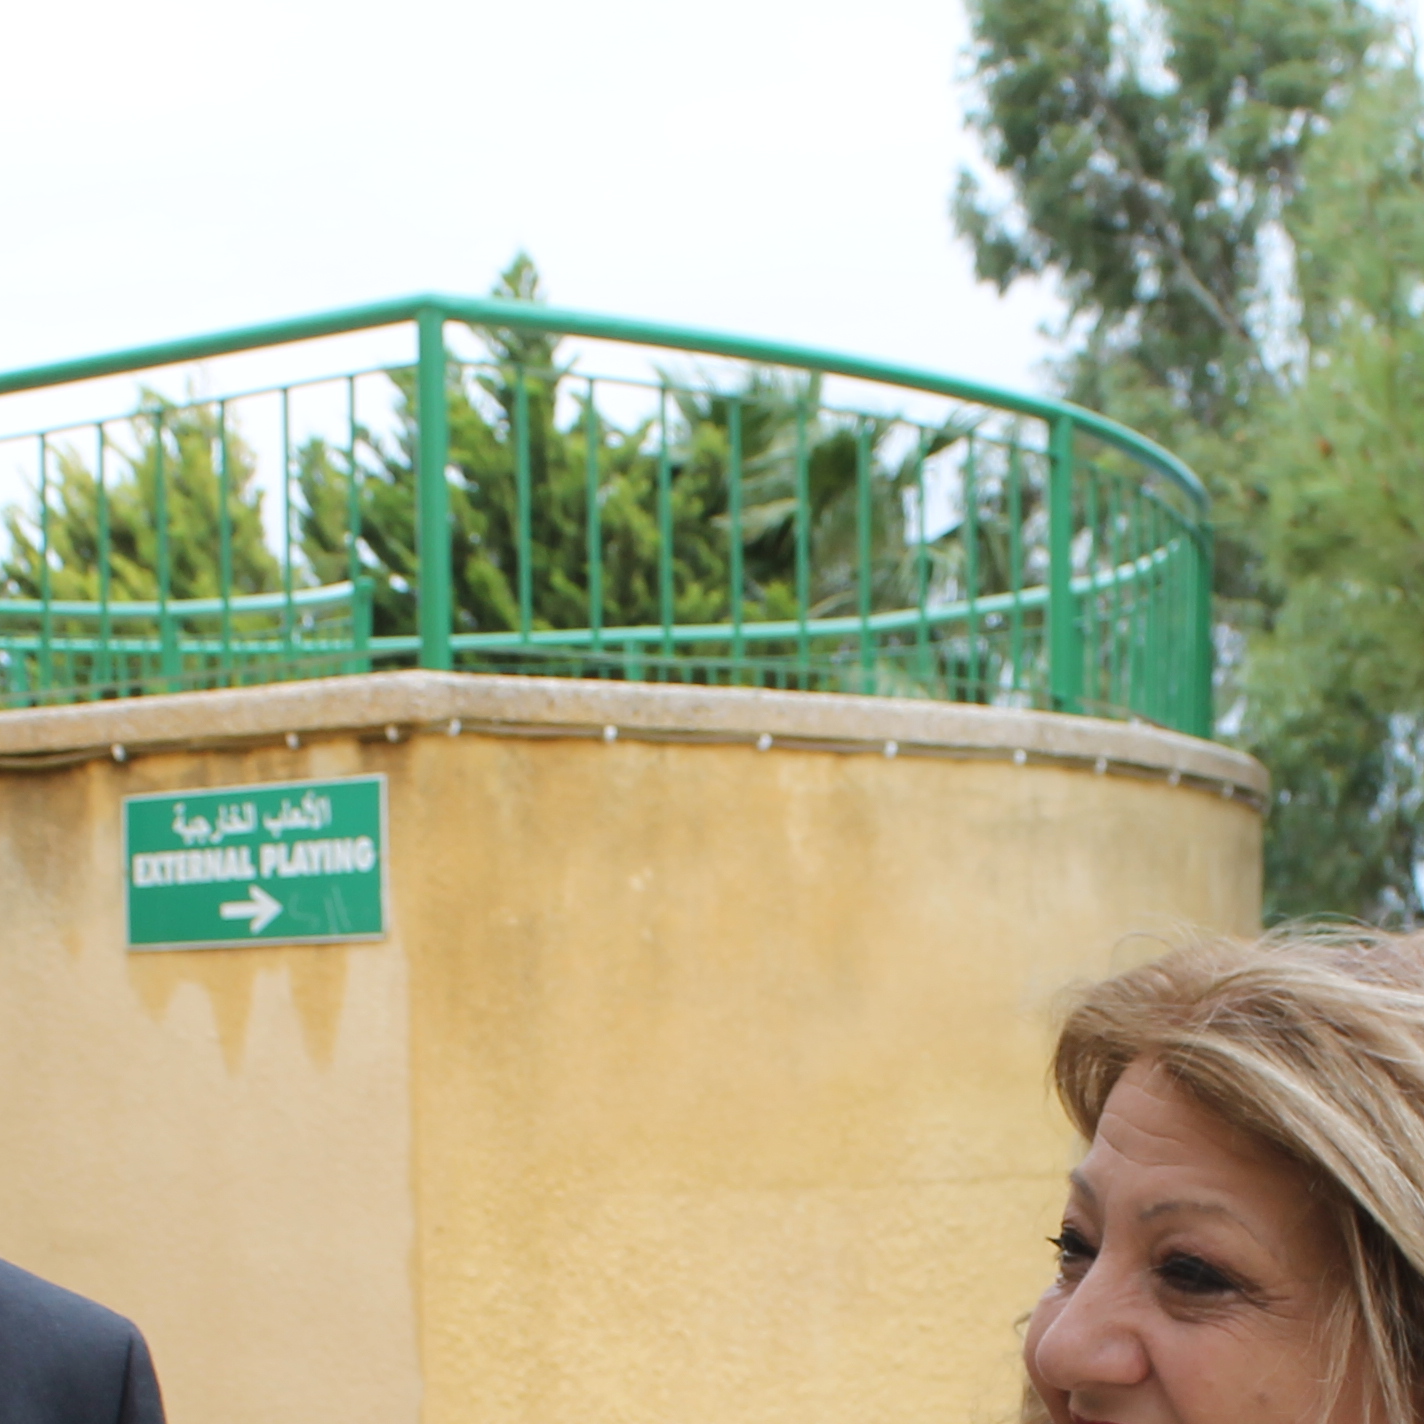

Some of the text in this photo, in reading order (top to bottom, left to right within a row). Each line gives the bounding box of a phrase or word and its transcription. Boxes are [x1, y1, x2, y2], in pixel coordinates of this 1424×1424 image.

[171, 801, 258, 846] الخارجية
[133, 835, 376, 887] EXTERNAL PLAYING
